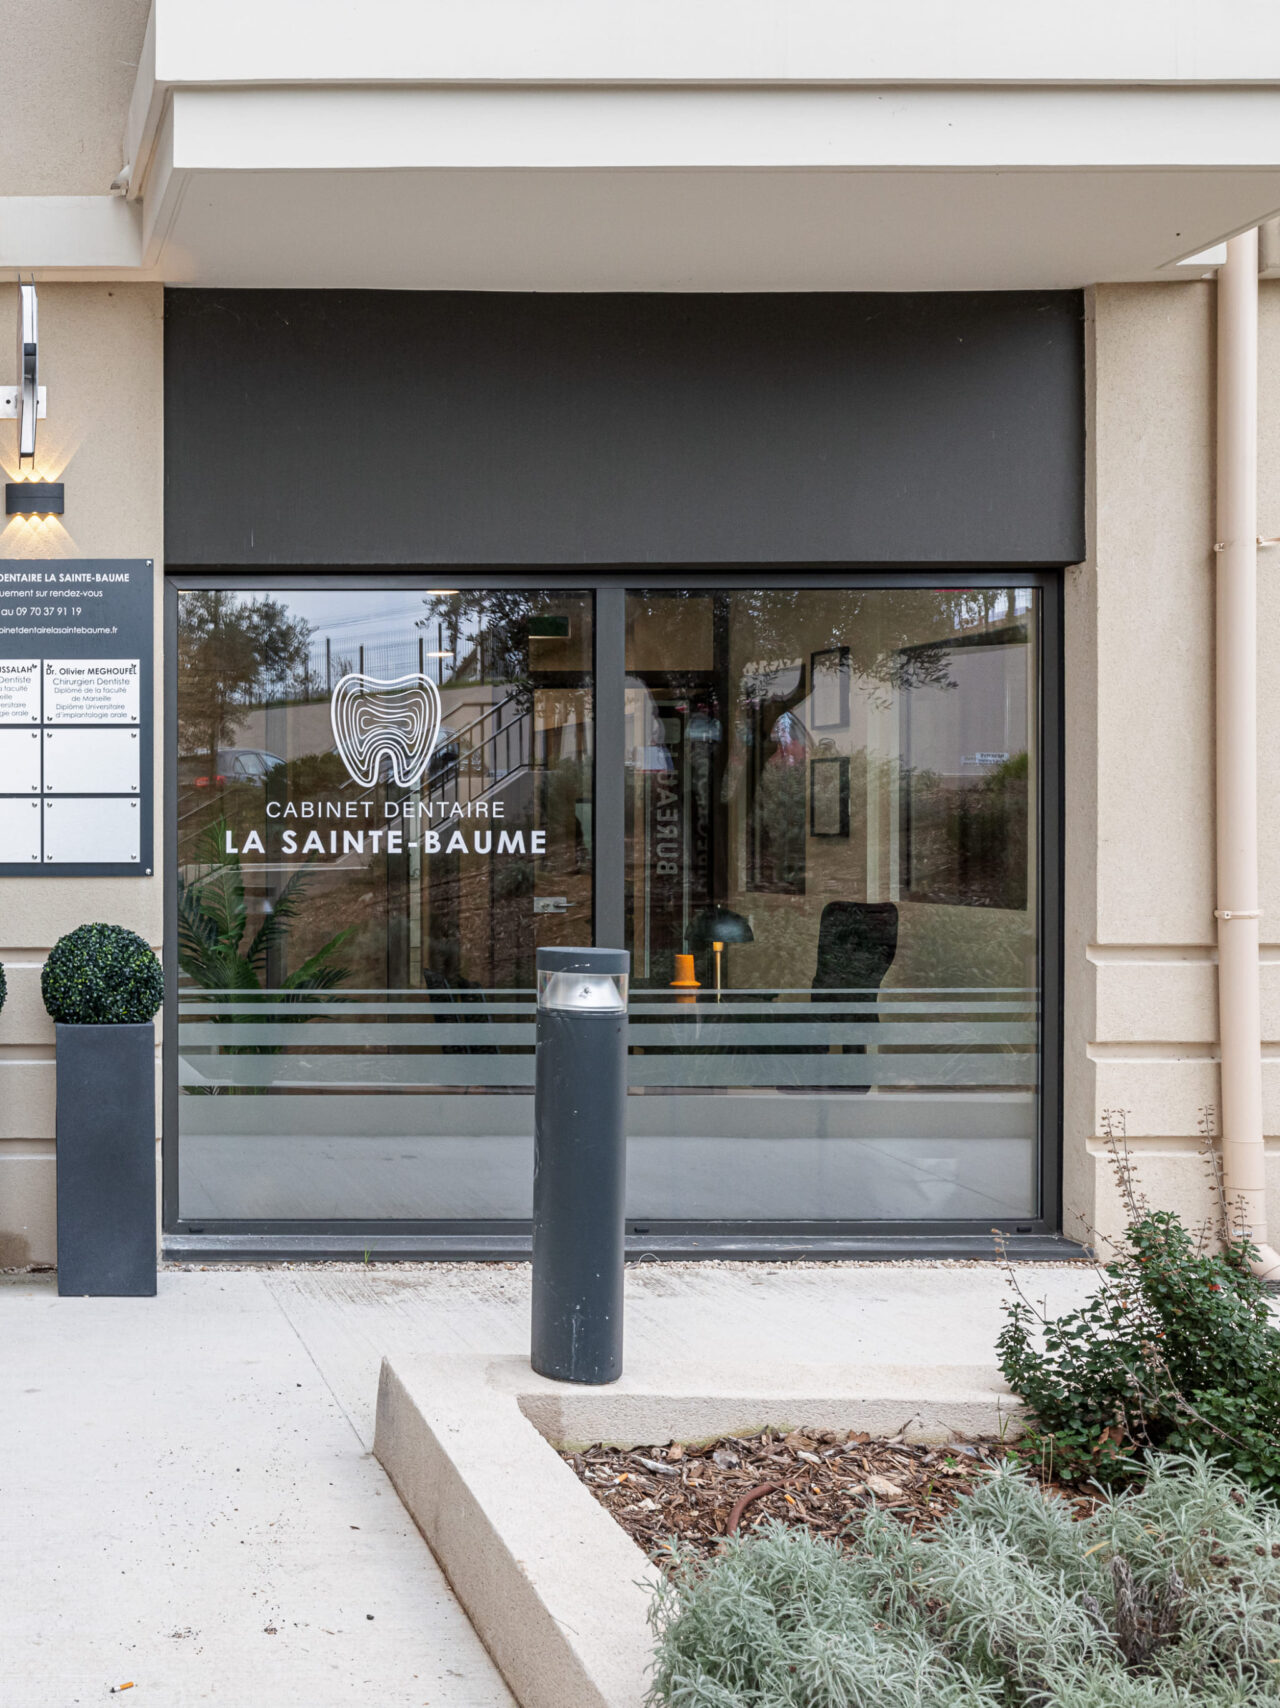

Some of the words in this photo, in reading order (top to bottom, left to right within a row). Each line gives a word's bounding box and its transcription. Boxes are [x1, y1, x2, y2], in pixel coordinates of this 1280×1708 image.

[45, 573, 57, 583] LA
[58, 573, 130, 583] SAINTE-BAUME
[49, 589, 103, 598] rendez-vous
[16, 607, 27, 616] 09
[30, 607, 42, 616] 70
[43, 607, 55, 616] 37
[56, 607, 68, 616] 91
[71, 607, 82, 616] 19
[45, 667, 57, 675] Dr.
[59, 667, 85, 675] Olivier
[52, 677, 95, 686] Chirurgien
[96, 677, 131, 685] Dentiste
[266, 801, 374, 818] CABINET
[384, 801, 505, 818] DENTAIRE
[225, 830, 265, 854] LA
[281, 830, 547, 854] SAINTE-BAUME
